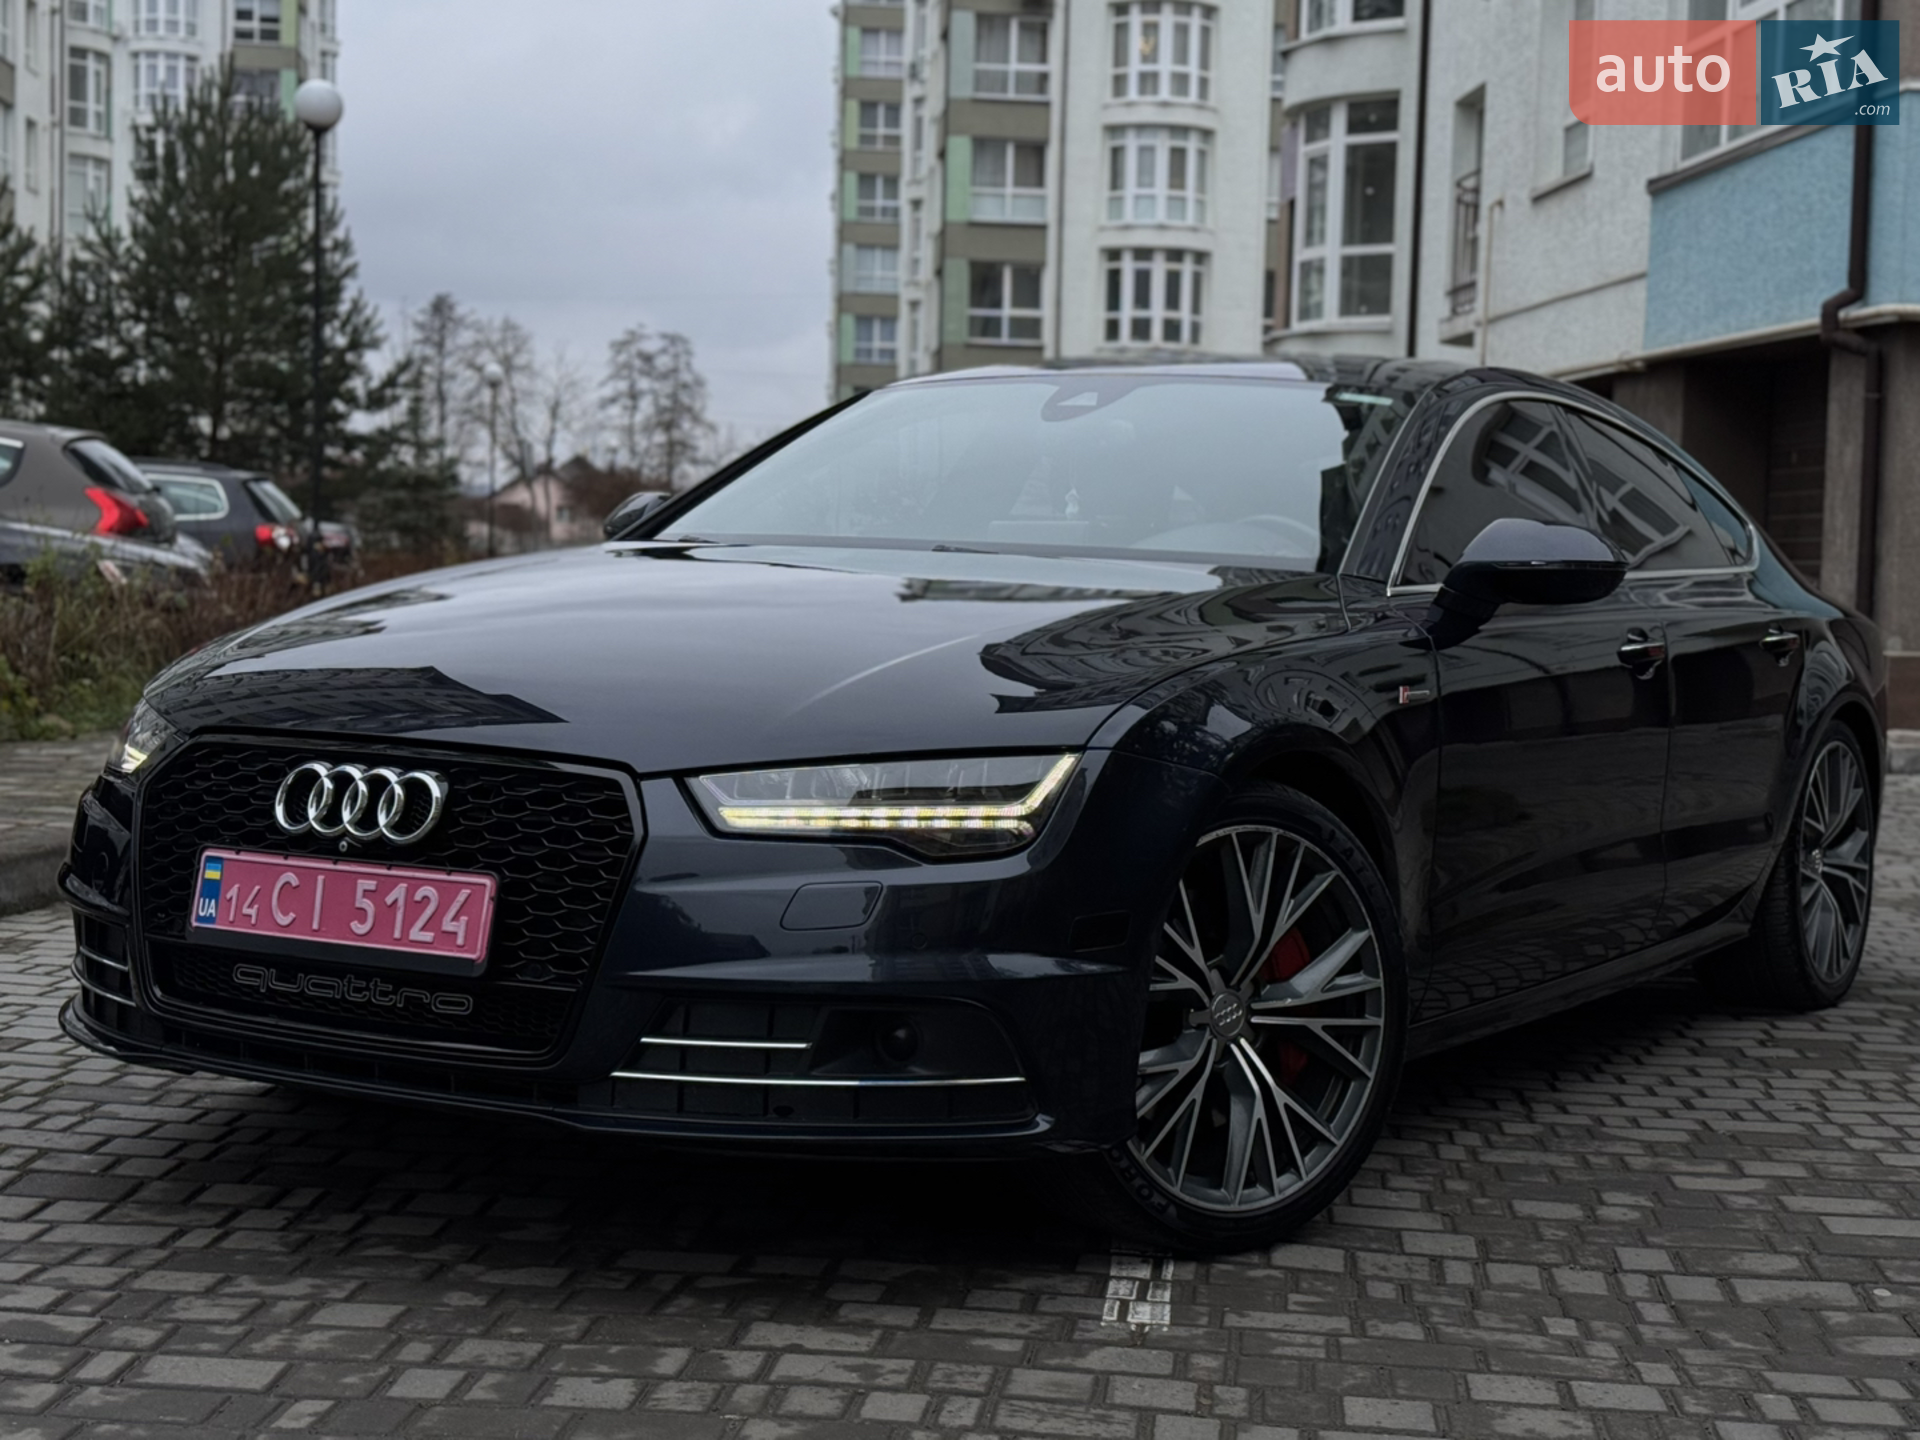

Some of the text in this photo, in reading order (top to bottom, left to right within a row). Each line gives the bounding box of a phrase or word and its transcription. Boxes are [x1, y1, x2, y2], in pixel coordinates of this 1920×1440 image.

[198, 898, 216, 918] UA
[349, 879, 472, 947] 5124
[233, 963, 473, 1015] quattro
